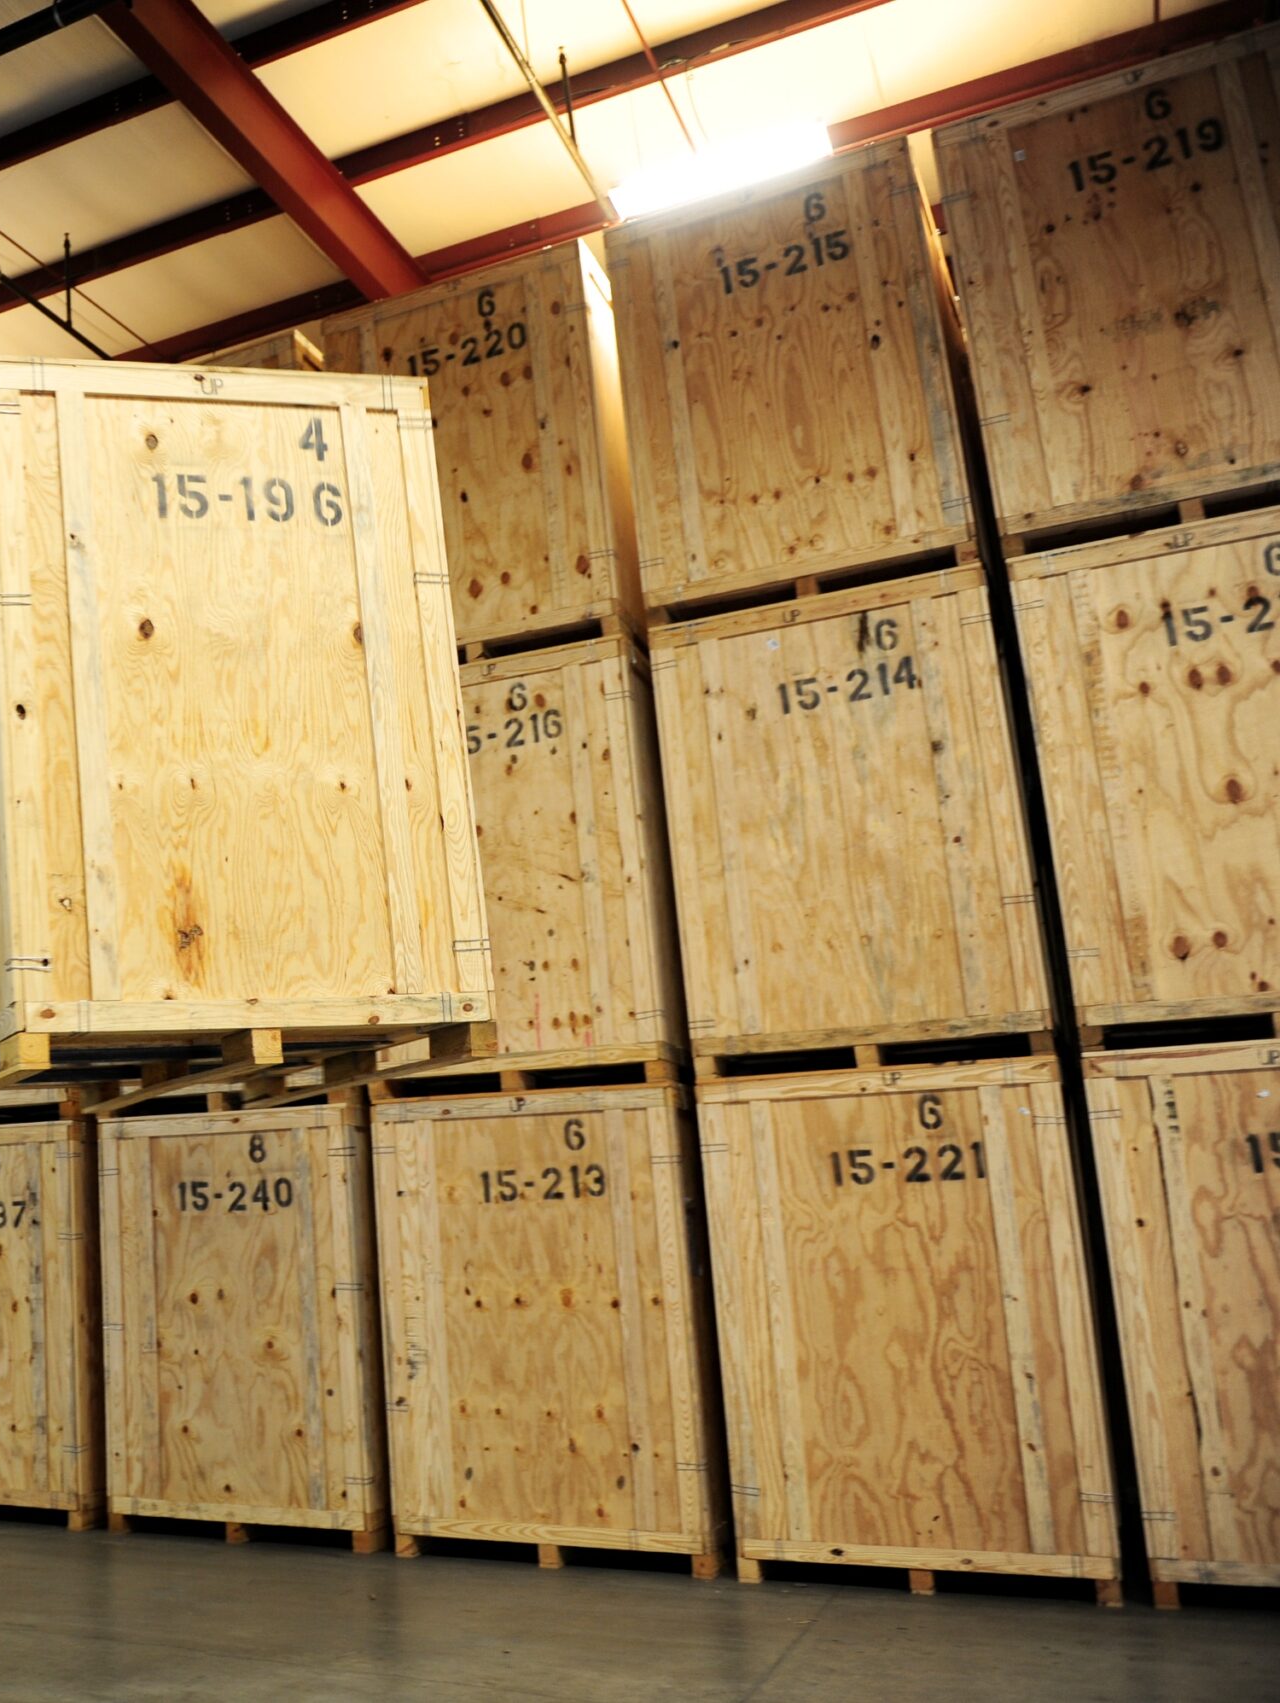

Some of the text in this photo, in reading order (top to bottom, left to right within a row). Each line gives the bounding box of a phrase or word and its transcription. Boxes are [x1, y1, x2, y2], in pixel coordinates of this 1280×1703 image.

[1145, 88, 1171, 121] 6
[1068, 117, 1224, 192] 15-219
[804, 191, 826, 222] 6
[720, 229, 850, 295] 15-215
[477, 288, 496, 317] 6
[407, 321, 527, 377] 15-220
[200, 376, 224, 396] UP
[298, 416, 329, 462] 4
[782, 608, 801, 624] UP
[875, 618, 899, 651] 6
[508, 681, 528, 712] 6
[777, 655, 918, 716] 15-214
[466, 708, 563, 755] 5-216
[882, 1071, 903, 1087] UP
[920, 1093, 943, 1130] 6
[249, 1133, 267, 1164] 8
[563, 1118, 586, 1151] 6
[830, 1140, 987, 1187] 15-221
[177, 1176, 294, 1213] 15-240
[480, 1163, 606, 1204] 15-213
